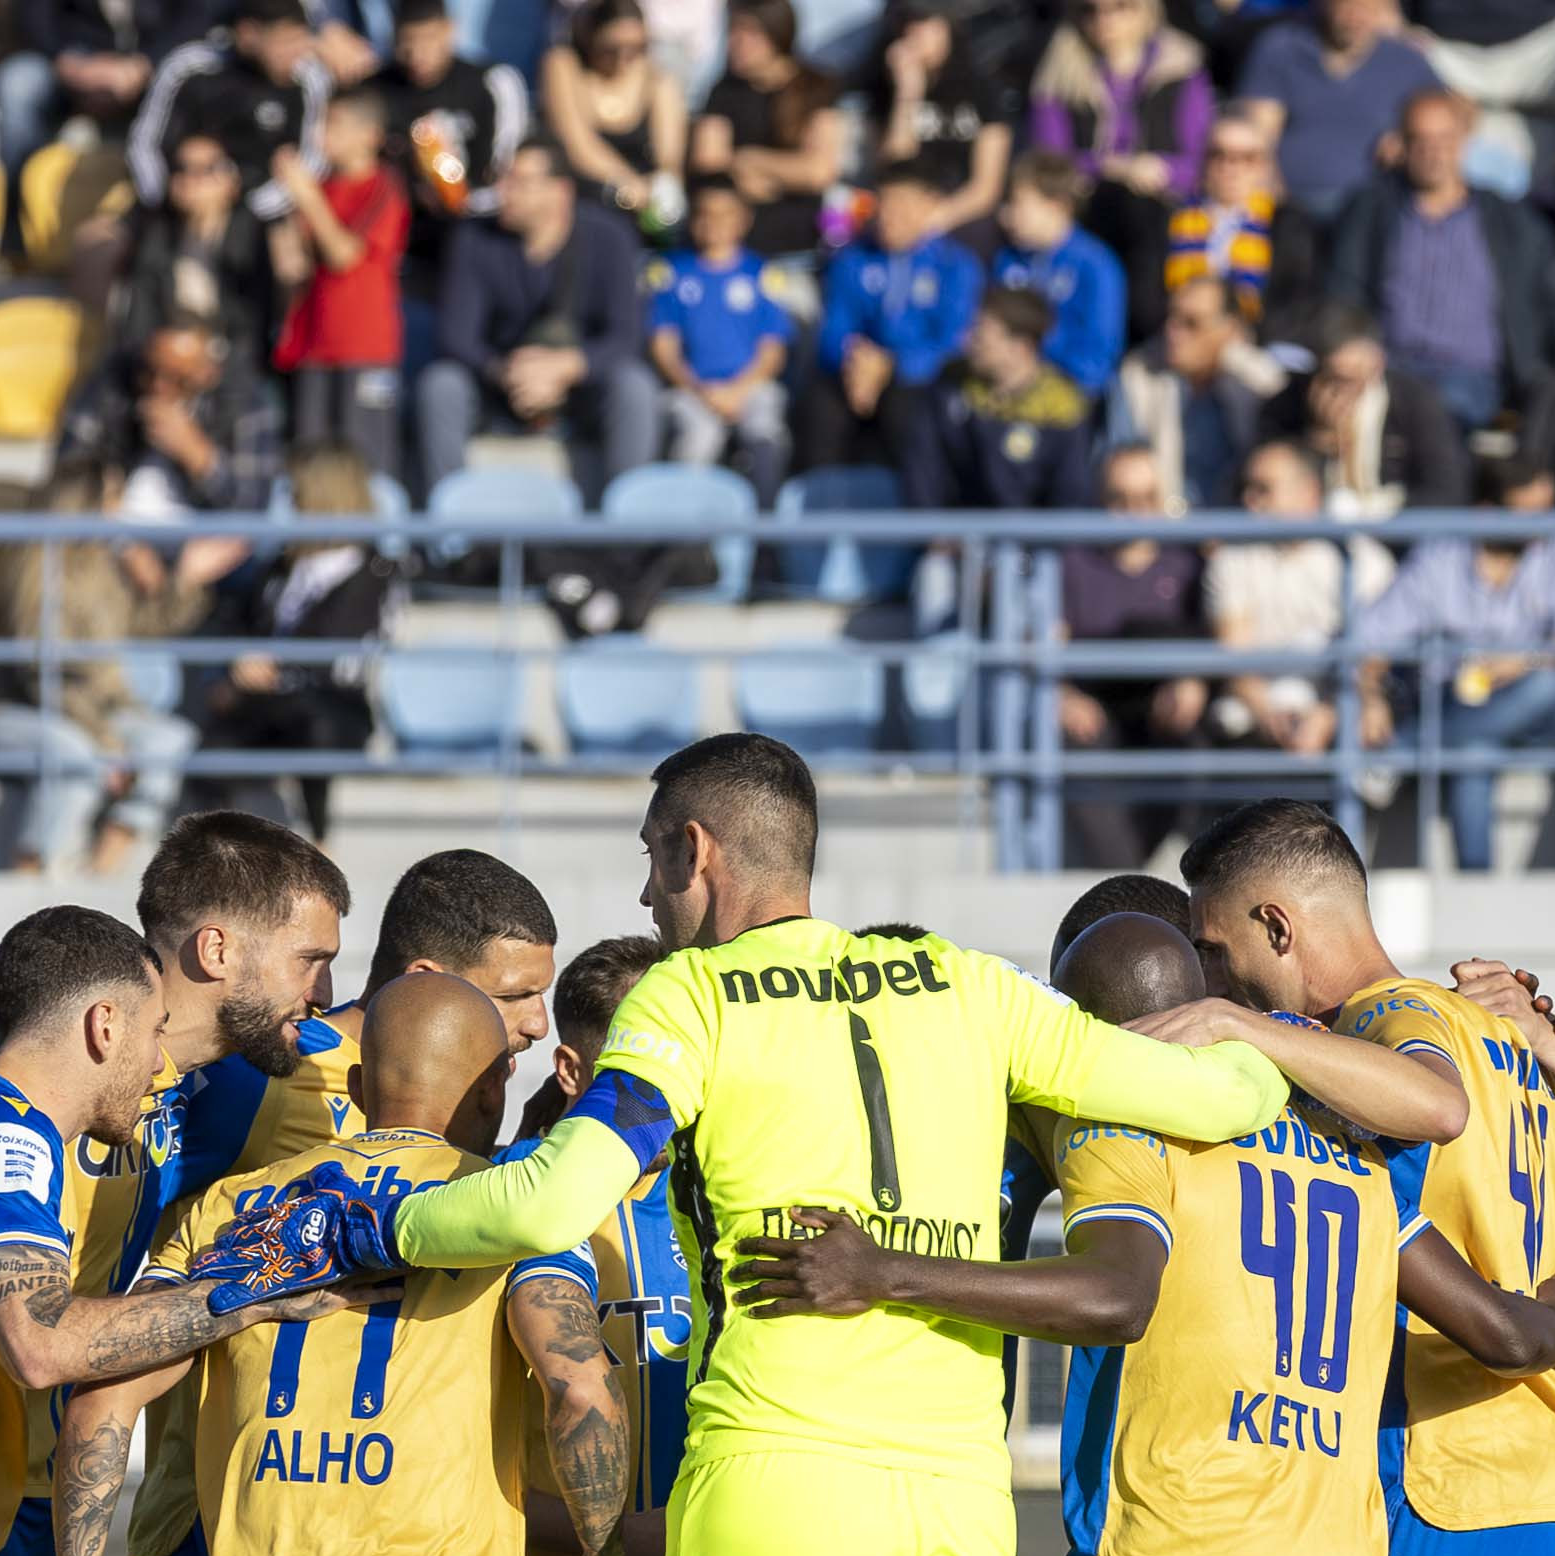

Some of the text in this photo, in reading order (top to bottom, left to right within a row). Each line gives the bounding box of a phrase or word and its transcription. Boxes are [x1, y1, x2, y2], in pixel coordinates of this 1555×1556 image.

[1237, 1161, 1360, 1393] 40
[255, 1429, 394, 1485] ALHO
[1228, 1390, 1342, 1457] KETU
